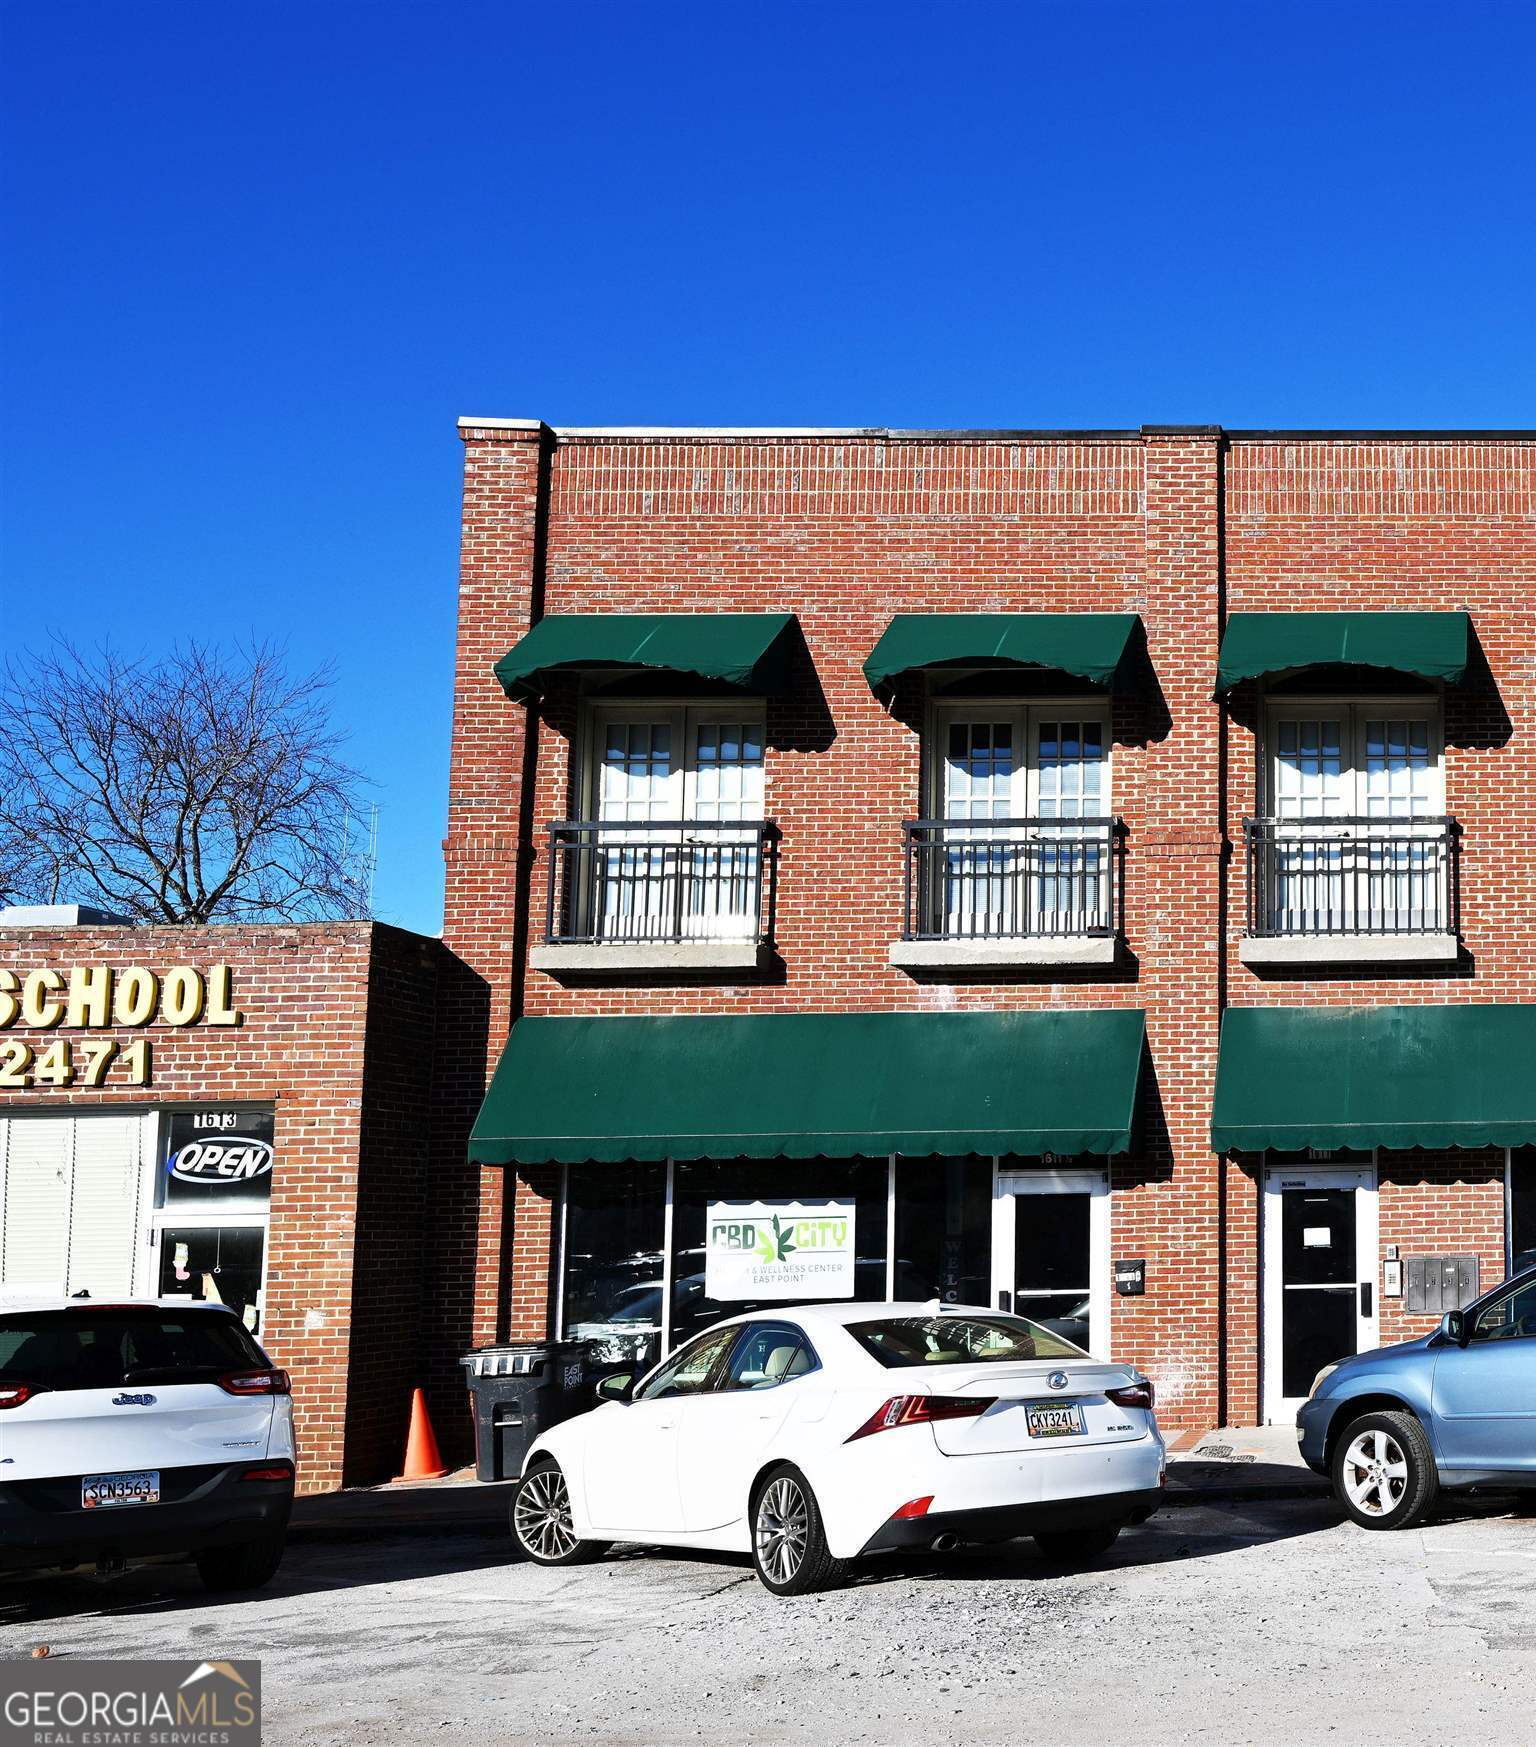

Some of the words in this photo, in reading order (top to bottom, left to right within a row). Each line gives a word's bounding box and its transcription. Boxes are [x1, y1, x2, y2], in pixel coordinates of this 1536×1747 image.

[0, 1040, 151, 1087] 2471
[197, 1111, 236, 1127] 1613
[175, 1143, 266, 1178] OPEN
[712, 1224, 755, 1250] CBD
[760, 1265, 806, 1275] WELLNESS
[807, 1263, 843, 1272] CENTER
[753, 1275, 775, 1284] EAST
[777, 1274, 805, 1283] POINT
[112, 1392, 158, 1406] Jeep
[1030, 1411, 1073, 1429] CKY3241
[88, 1480, 151, 1499] SCN3563
